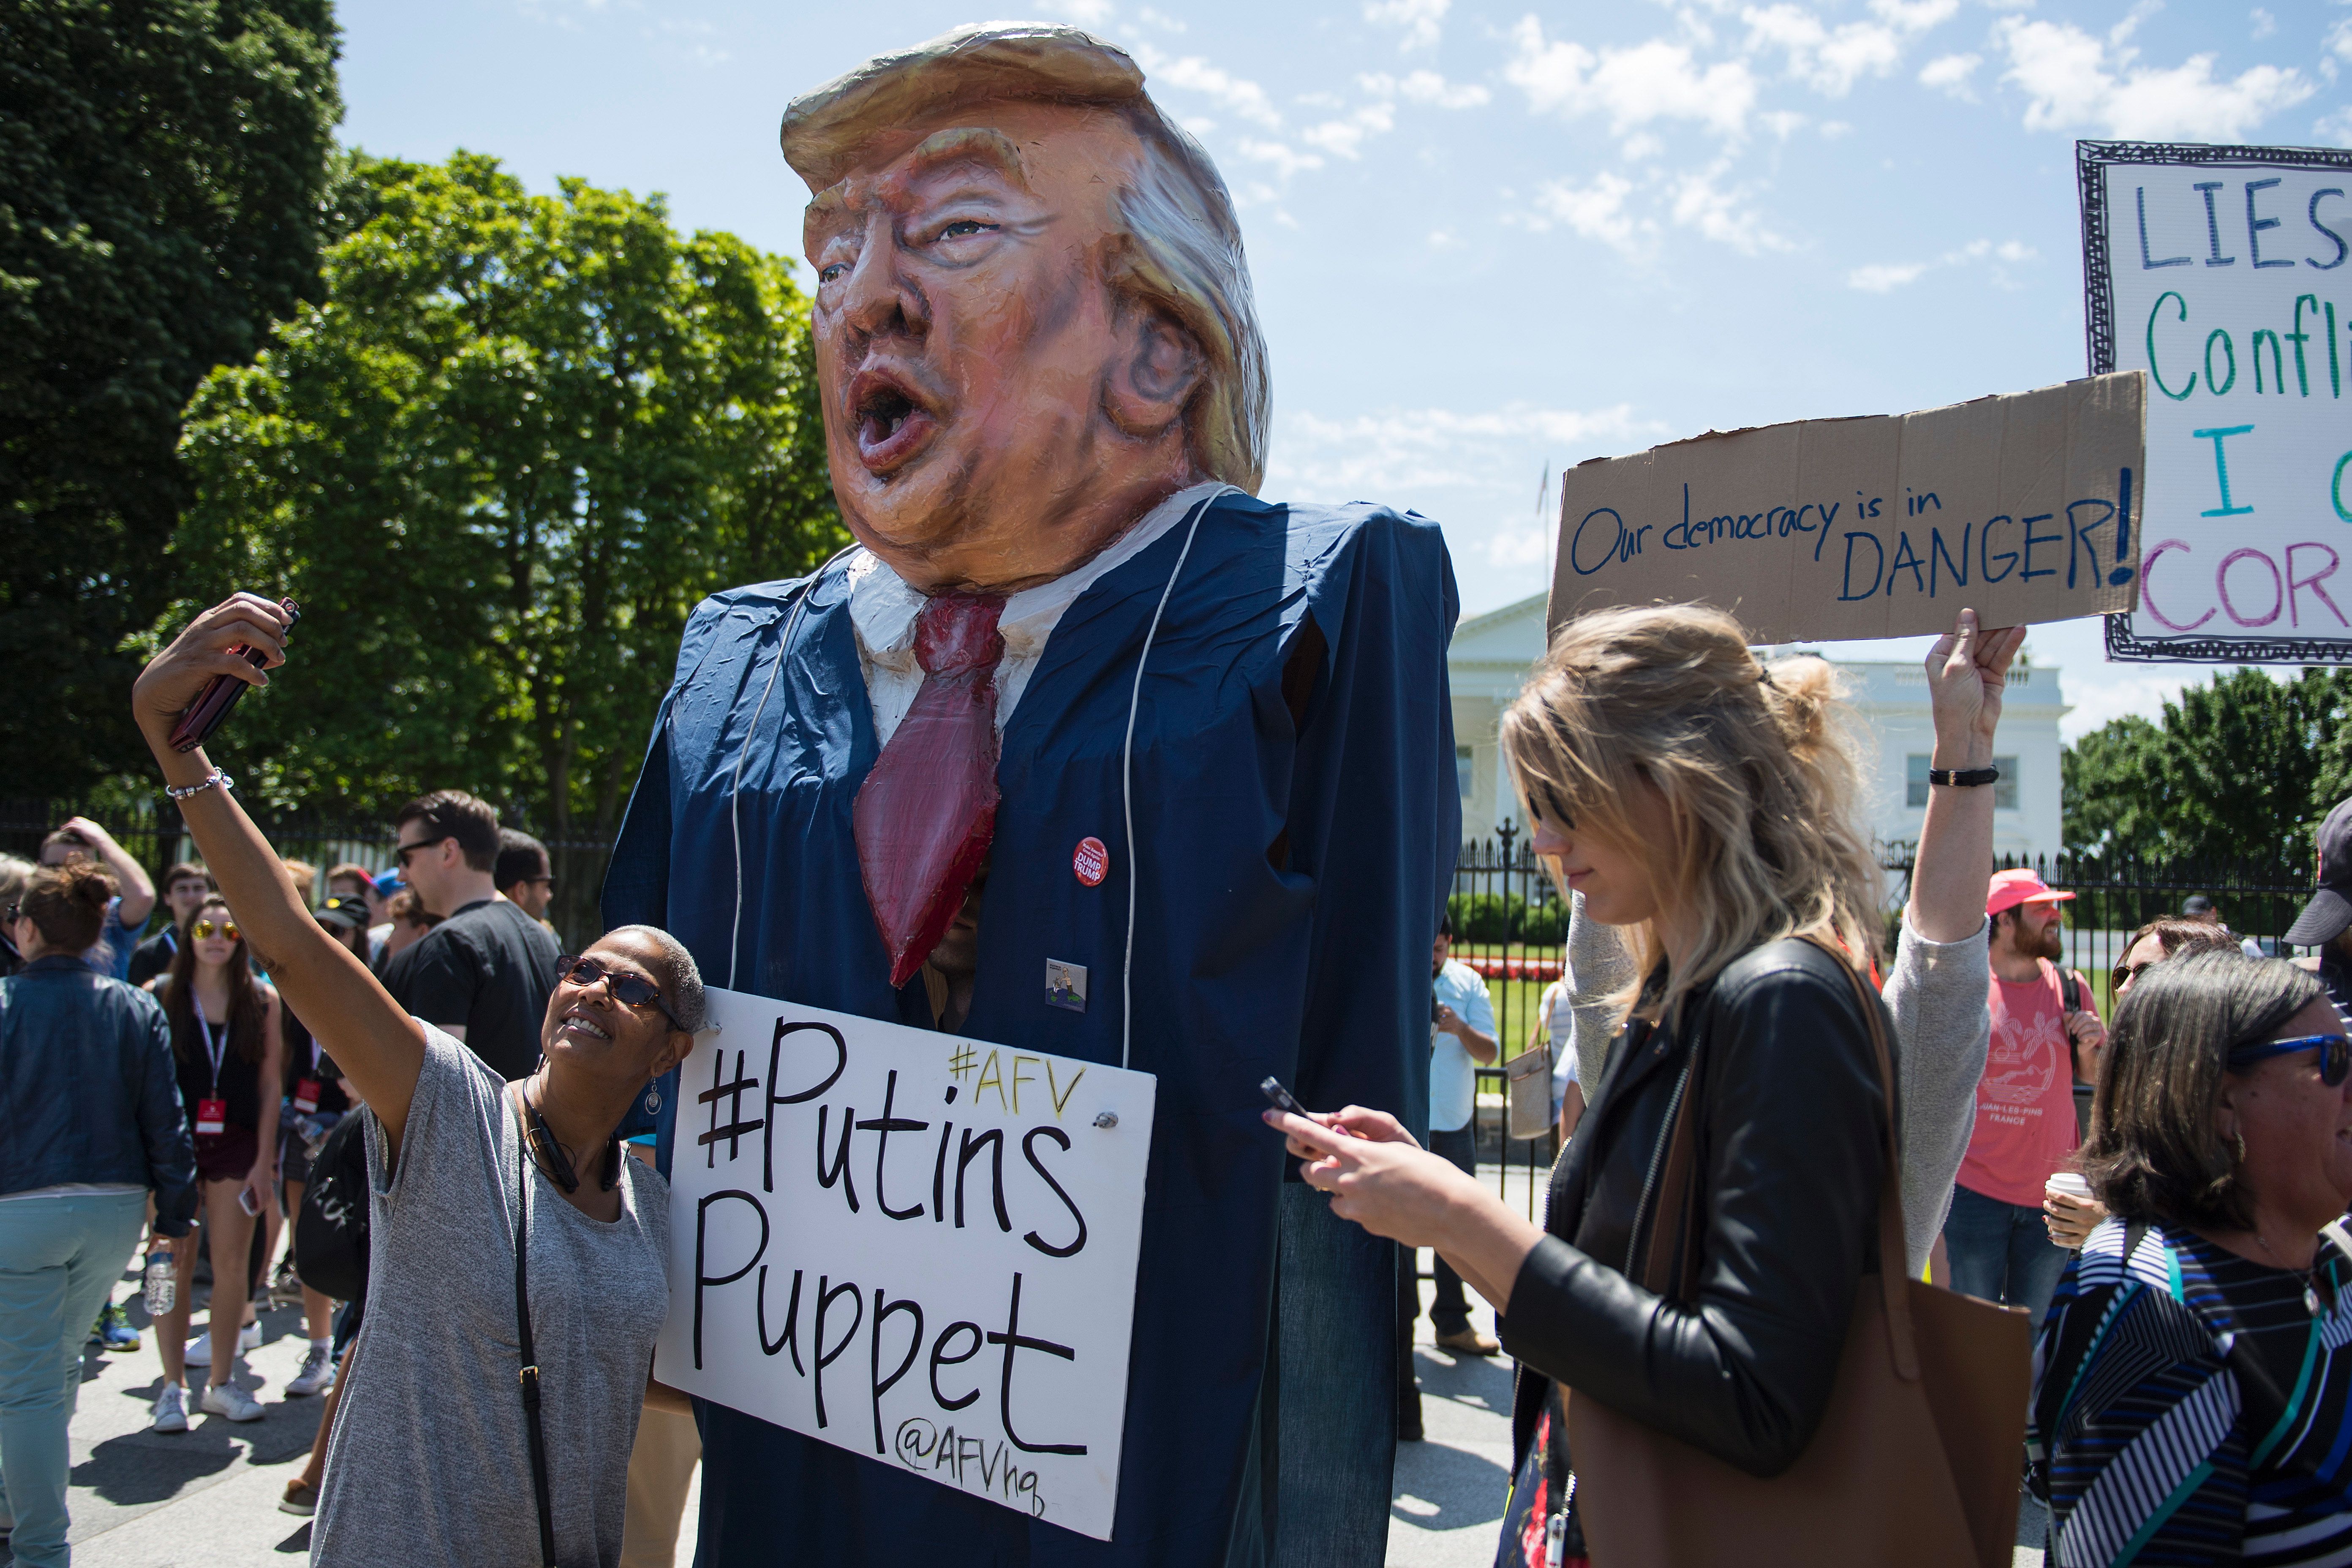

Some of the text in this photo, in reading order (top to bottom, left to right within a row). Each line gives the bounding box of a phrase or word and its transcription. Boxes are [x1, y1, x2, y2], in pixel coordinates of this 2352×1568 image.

[2137, 178, 2349, 270] LIES
[2146, 291, 2352, 401] Confl
[2192, 424, 2255, 517] I
[1571, 483, 1943, 575] Our democracy is in
[1838, 466, 2134, 601] DANGER!
[2142, 537, 2352, 632] COR
[1074, 859, 1100, 881] TRUMP
[1078, 852, 1101, 871] DUMP
[949, 1043, 1087, 1118] #AFV
[1990, 1113, 2026, 1125] FRANCE
[698, 1016, 1087, 1257] #Putins
[694, 1190, 1087, 1455] Puppet
